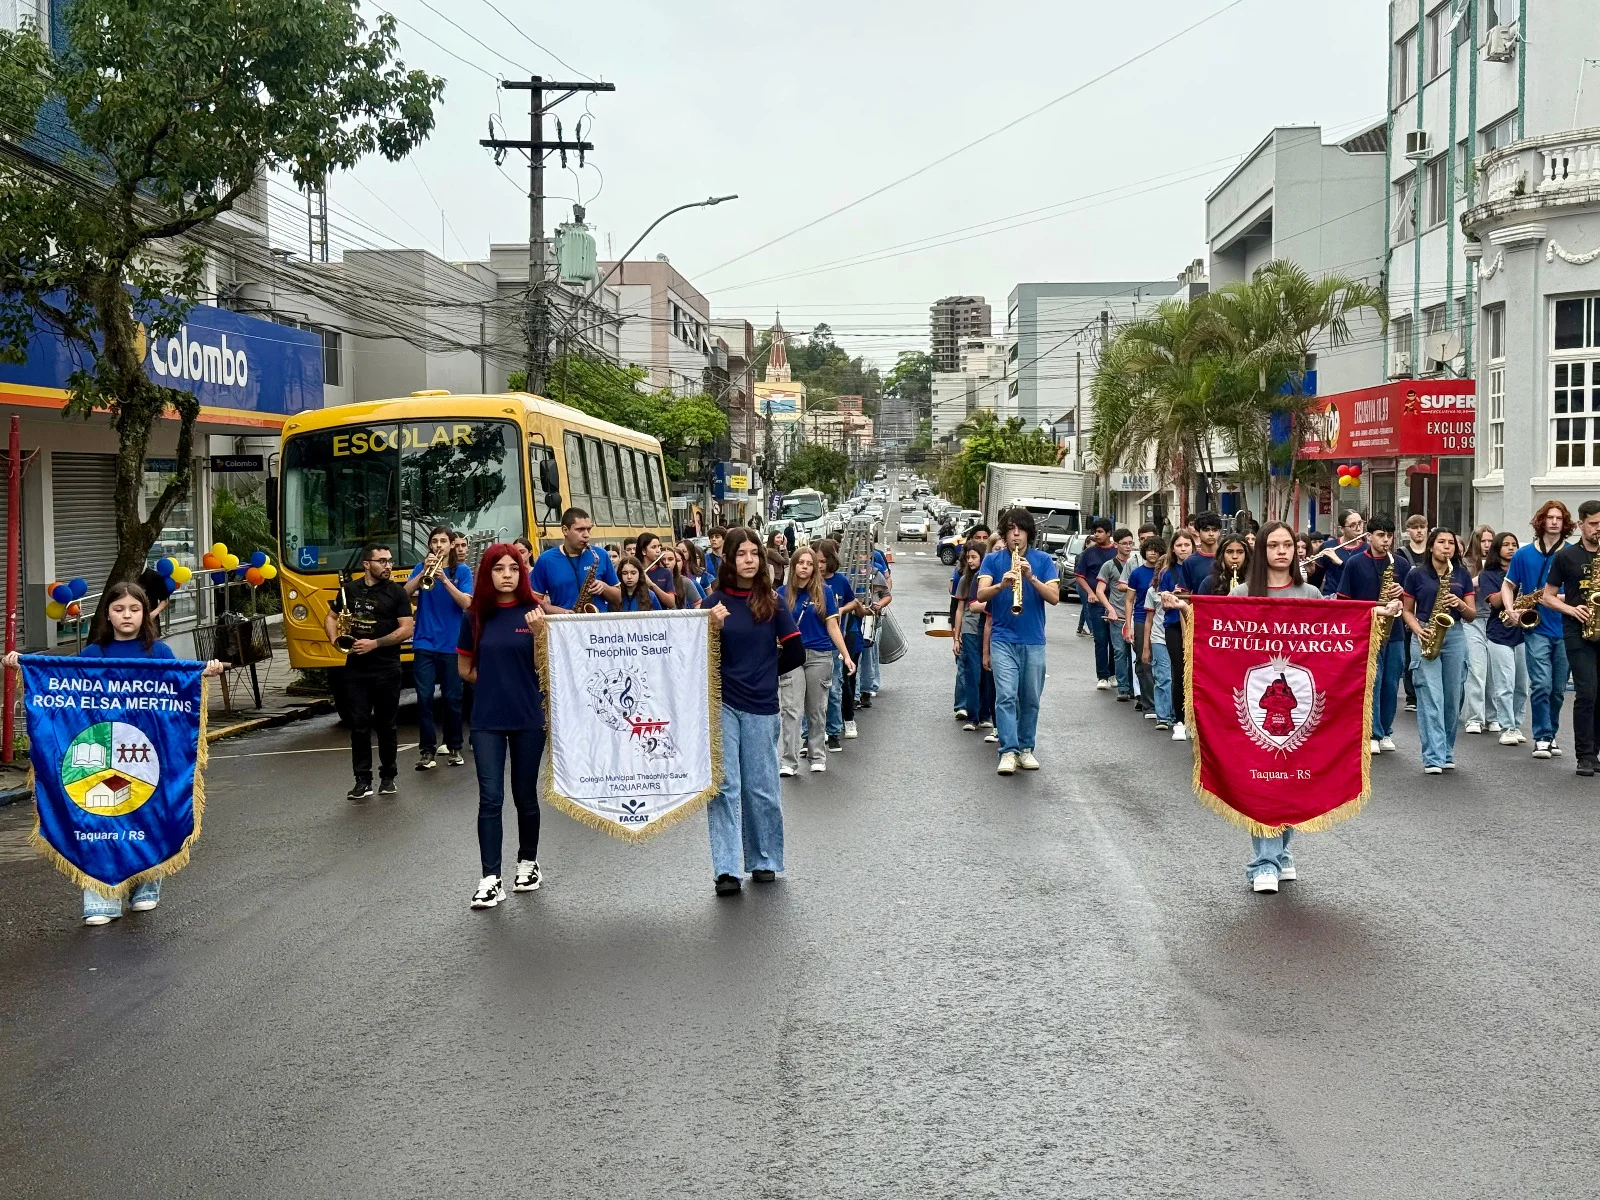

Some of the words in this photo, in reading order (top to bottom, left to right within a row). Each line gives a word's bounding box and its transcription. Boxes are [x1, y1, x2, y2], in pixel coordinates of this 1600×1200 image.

[151, 320, 248, 387] Colombo
[1420, 394, 1476, 408] SUPER
[333, 424, 473, 457] ESCOLAR
[1442, 436, 1476, 450] 10,99
[1212, 619, 1270, 634] BANDA
[1273, 622, 1351, 635] MARCIAL
[590, 633, 624, 645] Banda
[627, 631, 667, 643] Musical
[1208, 635, 1284, 652] GETÚLIO
[1287, 640, 1354, 653] VARGAS
[586, 645, 638, 659] Theóphilo
[641, 645, 672, 656] Sauer
[49, 678, 103, 692] BANDA
[108, 681, 178, 695] MARCIAL
[33, 695, 76, 708] ROSA
[81, 697, 121, 709] ELSA
[126, 698, 192, 713] MERTINS
[580, 775, 604, 783] Colégio
[606, 773, 635, 781] Municipal
[1250, 769, 1289, 781] Taquara
[1297, 769, 1311, 780] RS
[609, 783, 661, 792] TAQUARA/RS
[74, 831, 118, 842] Taquara
[129, 831, 145, 841] RS
